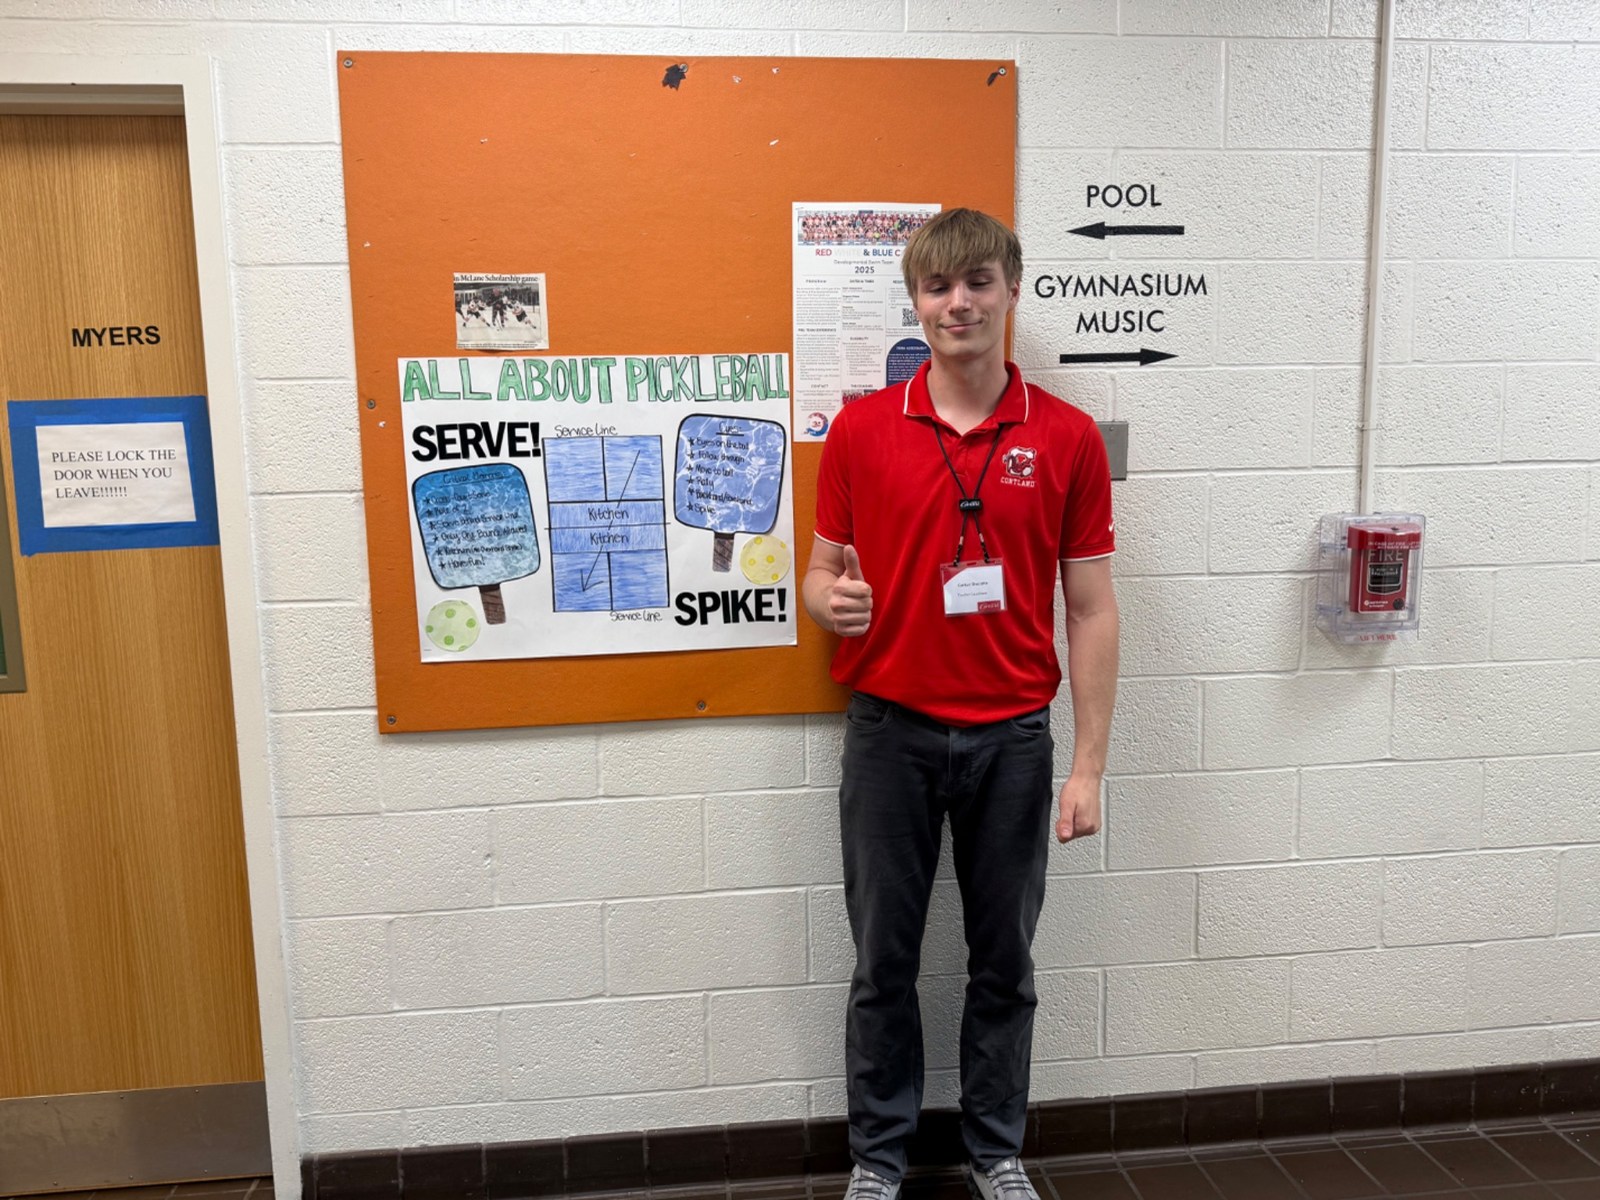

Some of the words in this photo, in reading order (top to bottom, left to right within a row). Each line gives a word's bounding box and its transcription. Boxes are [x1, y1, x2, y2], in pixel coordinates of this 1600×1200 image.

[1086, 183, 1162, 208] POOL
[815, 248, 832, 257] RED
[863, 249, 871, 257] &
[872, 248, 894, 257] BLUE
[854, 266, 875, 274] 2025
[484, 274, 521, 283] Scholarship
[521, 276, 539, 284] game
[1034, 273, 1208, 299] GYMNASIUM
[1075, 309, 1165, 334] MUSIC
[71, 325, 161, 347] MYERS
[402, 357, 492, 402] ALL
[496, 356, 617, 403] ABOUT
[624, 353, 790, 402] PICKLEBALL
[554, 424, 594, 438] Service
[411, 421, 542, 463] SERVE!
[51, 450, 103, 463] PLEASE
[107, 449, 145, 462] LOCK
[148, 449, 177, 461] THE
[54, 469, 94, 481] DOOR
[98, 467, 139, 480] WHEN
[142, 466, 173, 478] YOU
[1000, 476, 1036, 488] CORTLAND
[55, 486, 128, 499] LEAVE!!!!!!
[587, 507, 630, 522] Kitchen
[589, 531, 630, 546] Kitchen
[1368, 548, 1404, 562] FIRE
[674, 587, 787, 626] SPIKE!
[609, 610, 643, 623] Service
